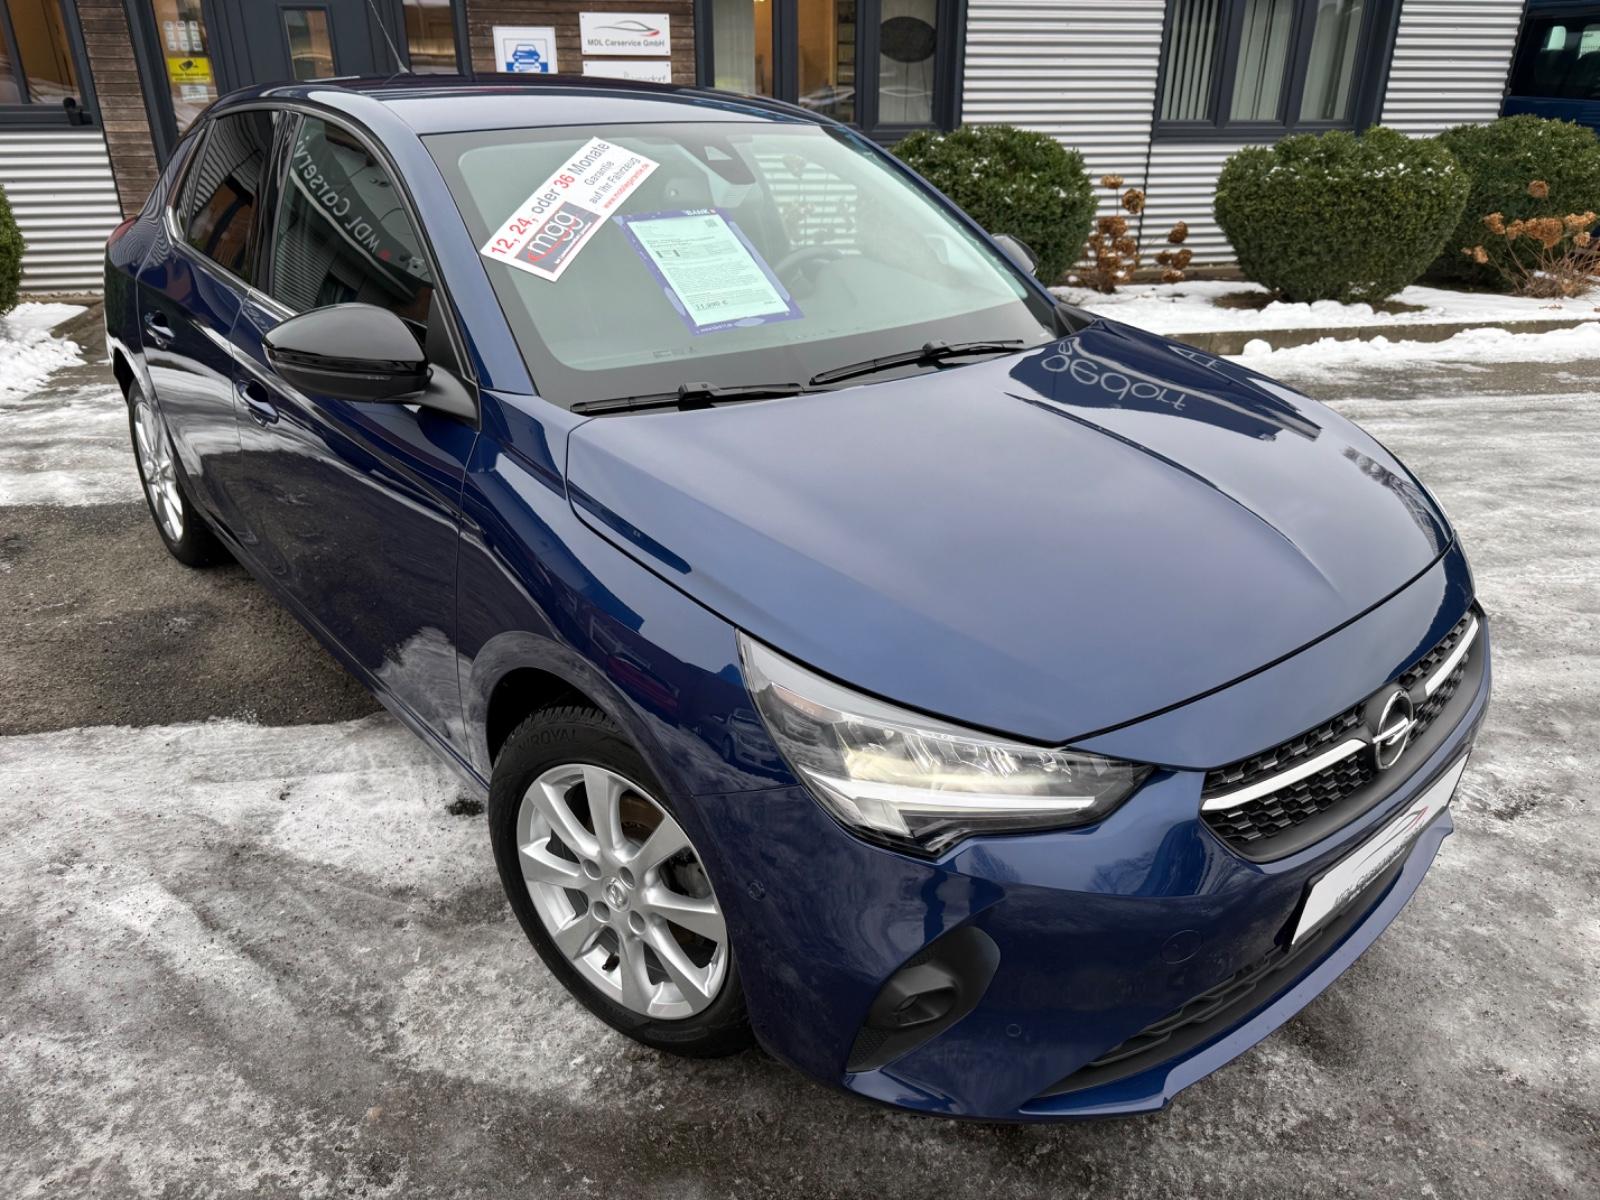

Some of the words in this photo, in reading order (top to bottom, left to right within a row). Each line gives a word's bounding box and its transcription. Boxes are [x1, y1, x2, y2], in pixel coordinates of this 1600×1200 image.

[605, 39, 641, 47] Carservice
[643, 39, 665, 47] GmbH
[584, 161, 614, 186] Garantie
[589, 190, 604, 204] auf
[607, 157, 641, 184] Fahrzeug
[491, 238, 521, 255] 12,
[509, 217, 539, 236] 24,
[531, 188, 560, 214] oder
[554, 173, 576, 189] 36
[567, 143, 610, 176] Monate
[527, 210, 584, 255] mgg
